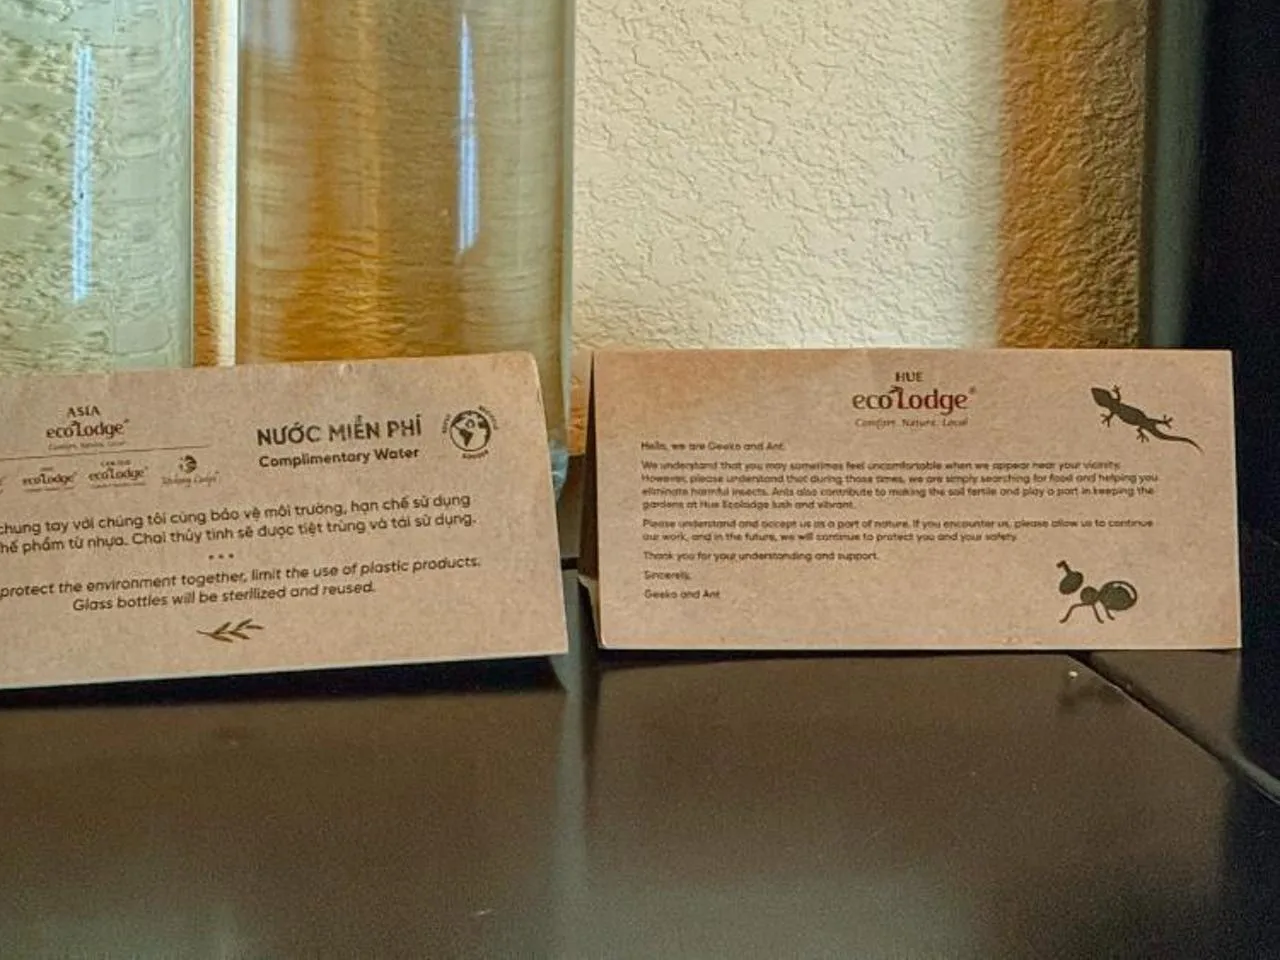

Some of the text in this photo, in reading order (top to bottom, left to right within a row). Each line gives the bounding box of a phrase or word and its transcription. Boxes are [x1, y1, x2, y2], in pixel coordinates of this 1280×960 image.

[895, 371, 924, 382] HUE
[67, 405, 101, 418] ASIA
[257, 422, 321, 446] NƯỚC
[328, 415, 381, 441] MIỄN
[387, 414, 422, 438] PHÍ
[259, 447, 420, 468] Complimentary Water
[44, 521, 68, 534] tay
[147, 512, 166, 525] tôi
[244, 507, 260, 521] vệ
[264, 504, 290, 517] môi
[350, 501, 378, 514] hạn
[433, 495, 470, 508] dụng
[131, 532, 166, 545] Chai
[206, 527, 233, 540] tinh
[370, 517, 387, 530] và
[0, 584, 55, 600] protect
[58, 581, 82, 593] the
[86, 576, 176, 592] environment
[251, 568, 280, 580] limit
[286, 567, 308, 578] the
[313, 566, 338, 577] use
[342, 562, 356, 575] of
[360, 560, 408, 576] plastic
[73, 598, 112, 611] Glass
[116, 595, 167, 608] bottles
[172, 591, 194, 605] will
[198, 590, 217, 603] be
[222, 587, 286, 602] sterilized
[290, 584, 318, 597] and
